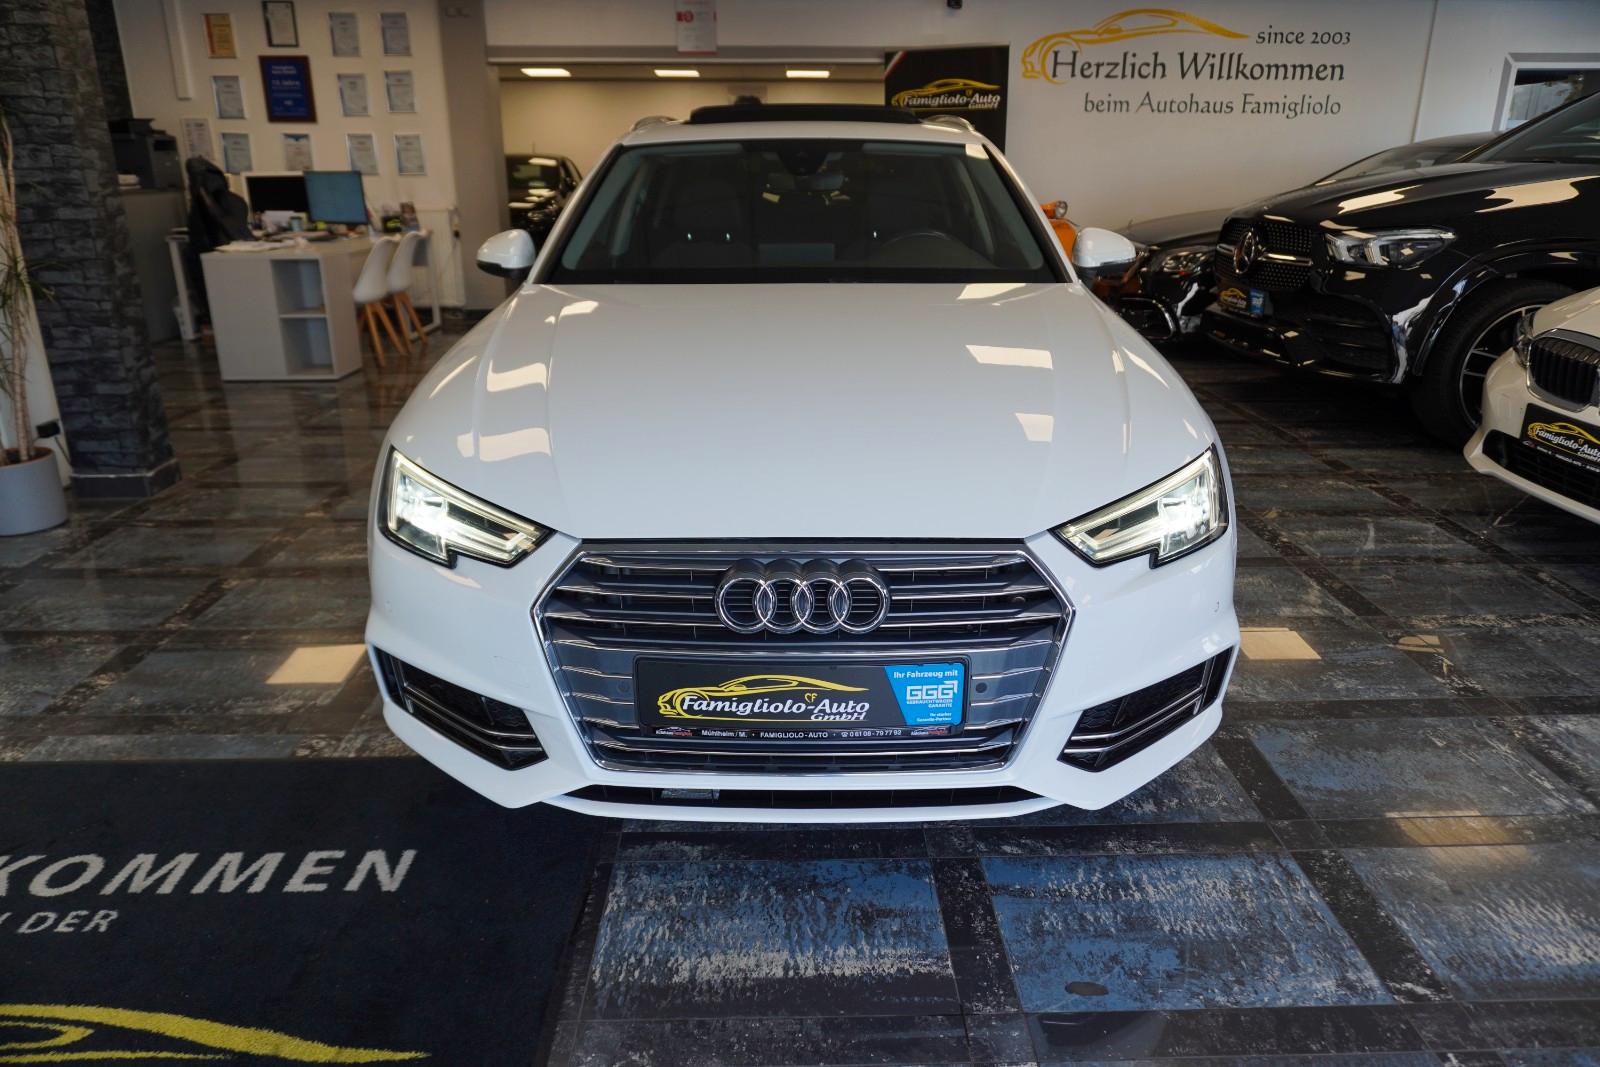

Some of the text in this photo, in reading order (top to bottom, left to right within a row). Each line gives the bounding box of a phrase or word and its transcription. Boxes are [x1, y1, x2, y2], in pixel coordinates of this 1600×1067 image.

[1256, 25, 1351, 45] since 2003
[1051, 50, 1345, 81] Herzlich Willkommen
[903, 93, 1001, 106] Famigliolo-Auto
[1084, 92, 1342, 120] beim Autohaus Famigliolo
[893, 668, 959, 679] Ihr Fahrzeug mit
[906, 684, 954, 700] GGG
[682, 696, 870, 715] Famigliolo-Auto
[810, 712, 867, 721] GmbH
[16, 909, 119, 934] DER
